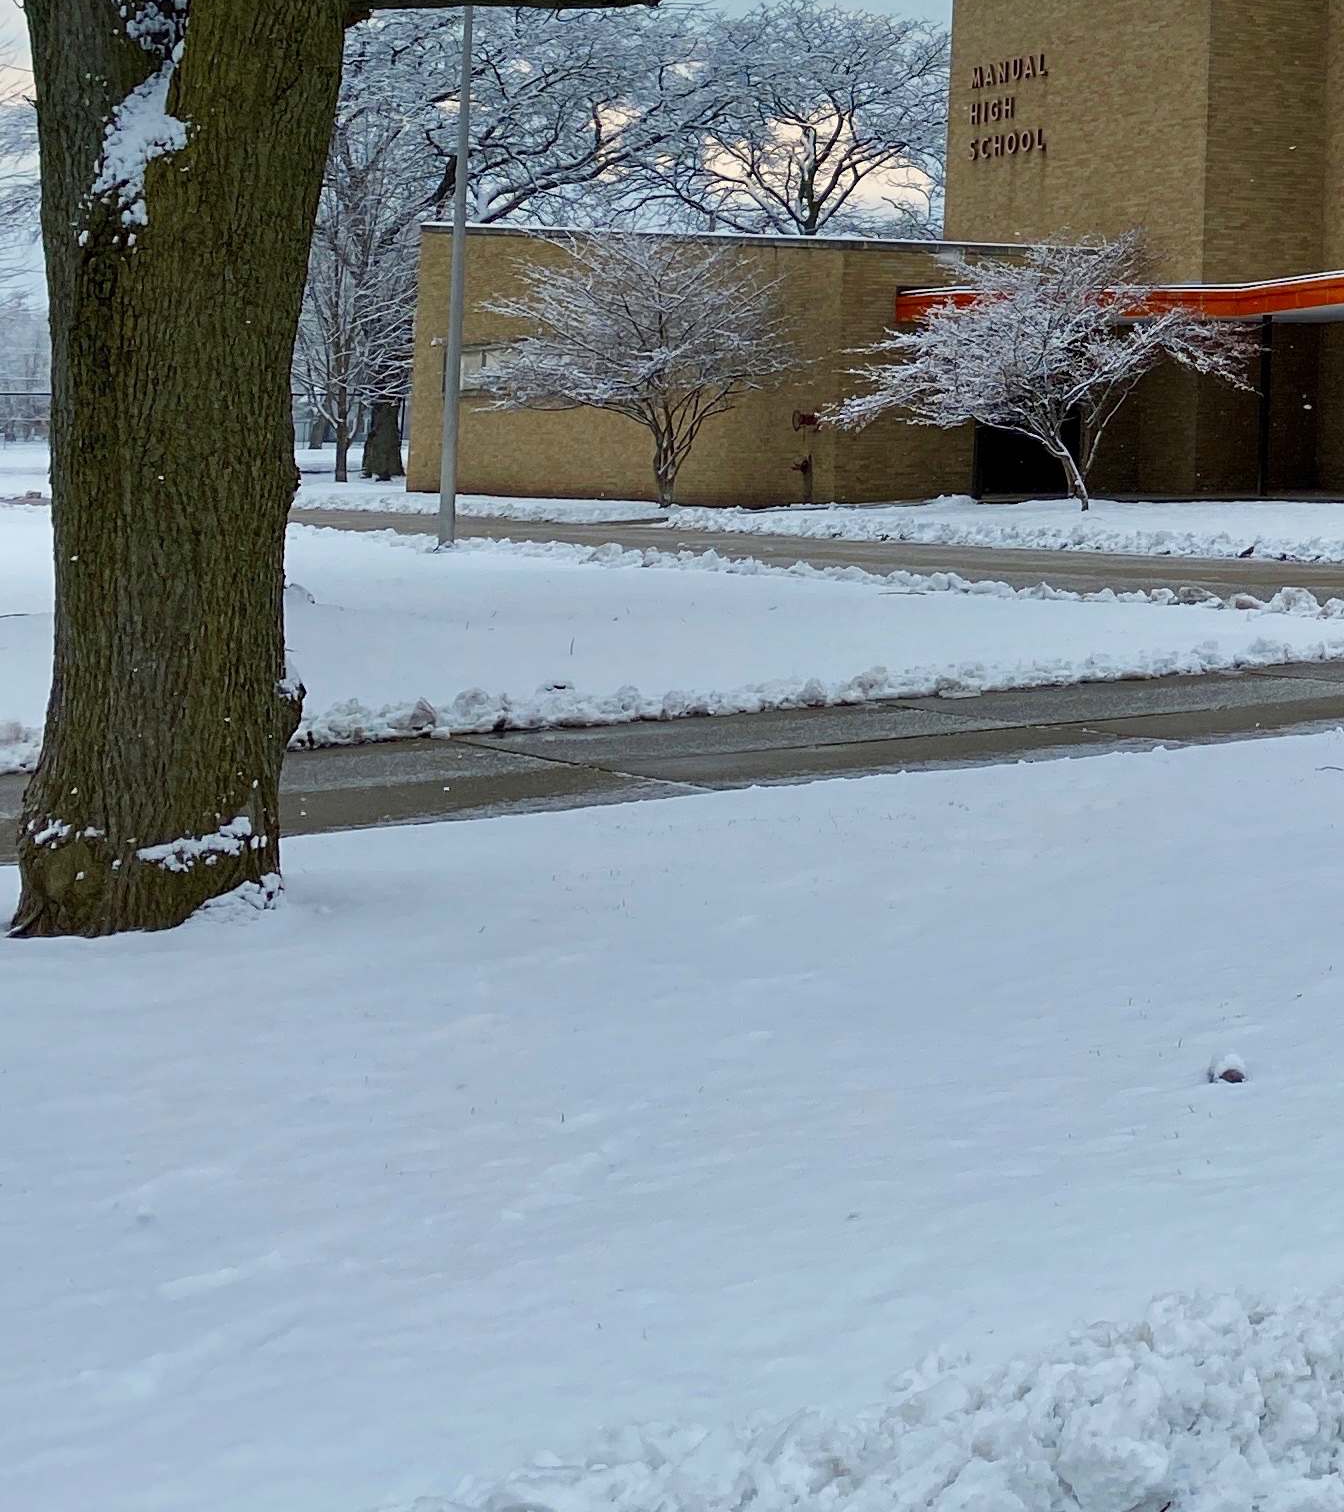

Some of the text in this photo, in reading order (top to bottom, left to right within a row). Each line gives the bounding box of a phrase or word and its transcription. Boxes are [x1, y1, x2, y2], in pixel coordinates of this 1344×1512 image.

[971, 53, 1048, 89] MANUAL
[969, 96, 1015, 125] HIGH
[968, 128, 1047, 161] SCHOOL
